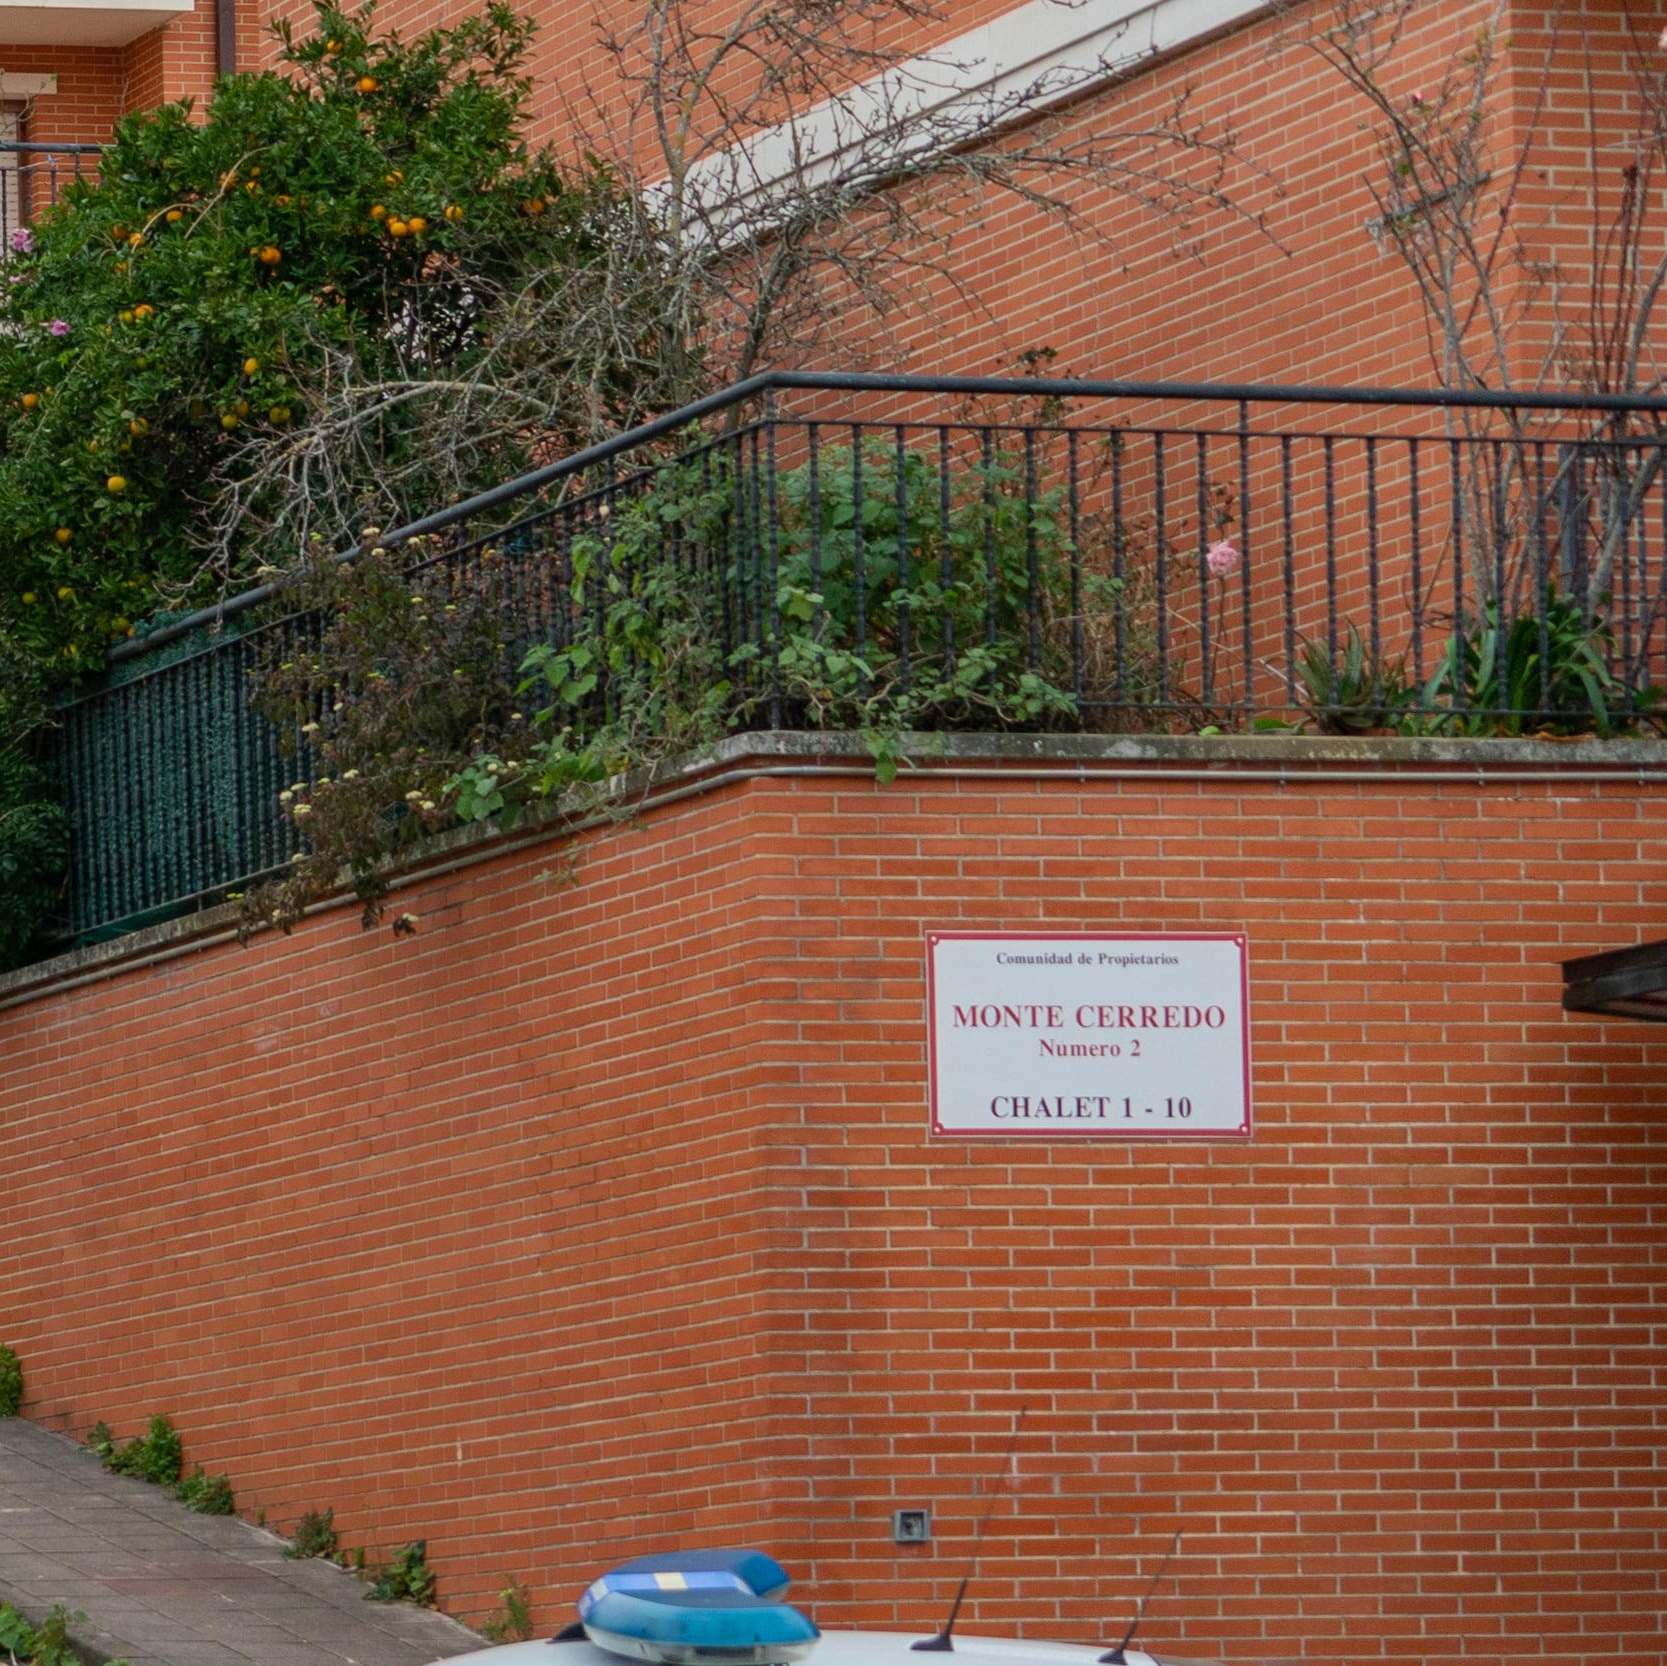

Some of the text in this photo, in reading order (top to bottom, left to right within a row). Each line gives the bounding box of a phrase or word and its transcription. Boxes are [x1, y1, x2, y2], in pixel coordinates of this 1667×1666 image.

[996, 952, 1180, 968] Comunidad de Propietarios
[952, 1004, 1227, 1029] MONTE CERREDO
[1129, 1038, 1142, 1057] 2
[990, 1096, 1111, 1119] CHALET
[1122, 1096, 1133, 1118] 1
[1164, 1096, 1192, 1118] 10
